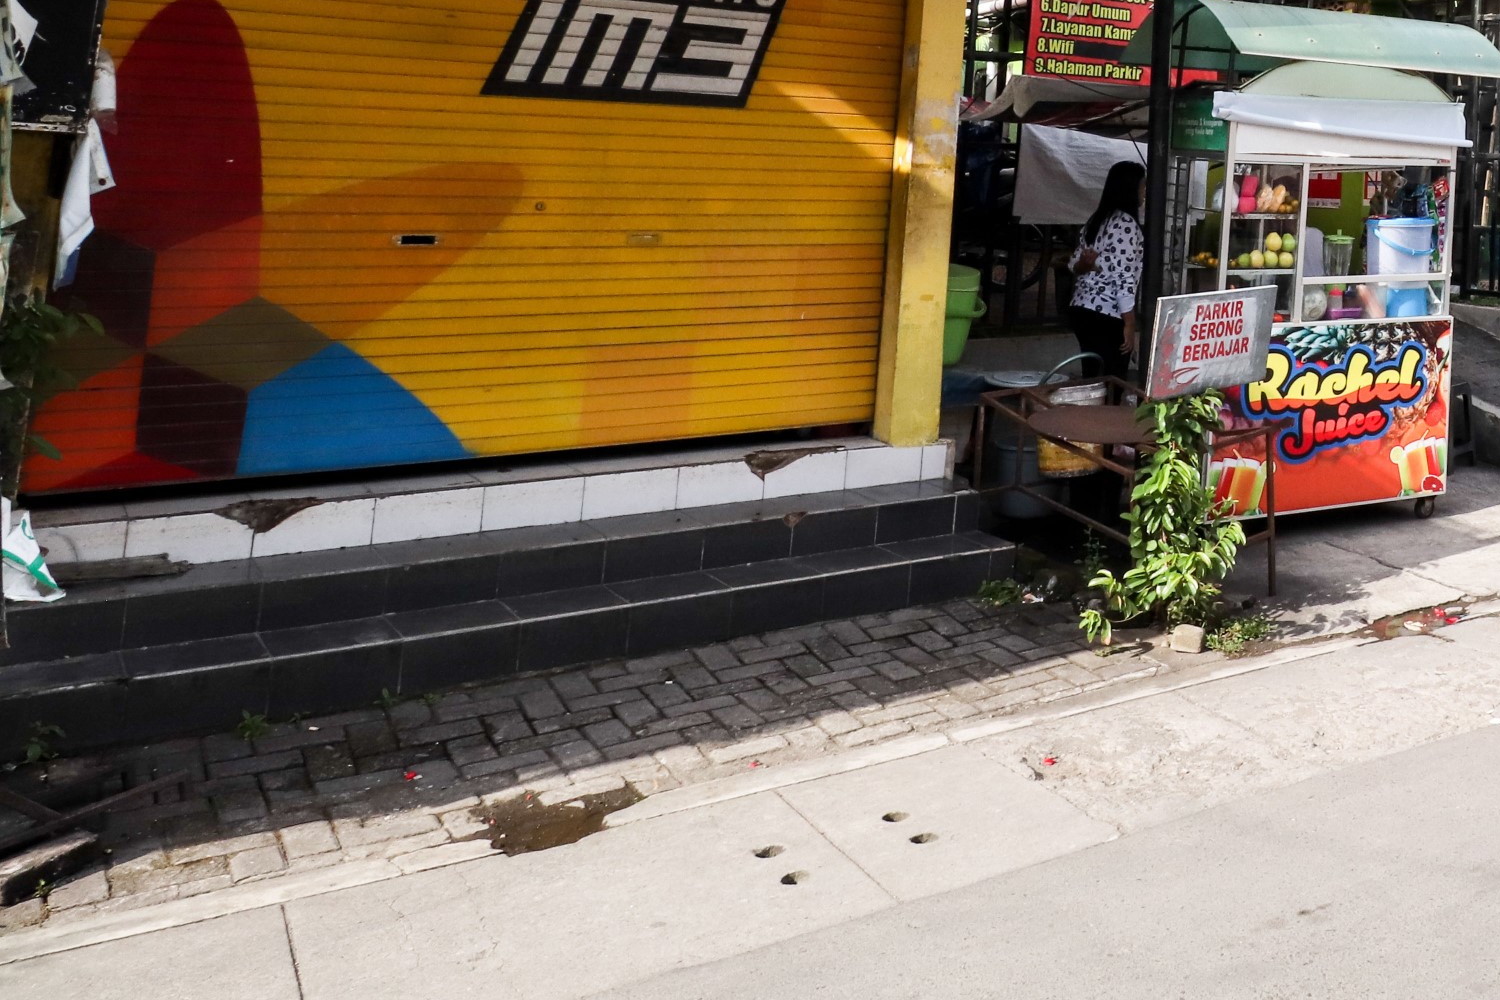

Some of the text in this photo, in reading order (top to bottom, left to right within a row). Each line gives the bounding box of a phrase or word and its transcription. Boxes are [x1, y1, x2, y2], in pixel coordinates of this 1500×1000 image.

[1091, 3, 1131, 21] Umum
[1104, 62, 1143, 81] Parkir
[1195, 299, 1244, 322] PARKIR
[1189, 317, 1244, 342] SERONG
[1181, 336, 1250, 363] BERJAJAR
[1246, 346, 1424, 413] Rachel
[1282, 401, 1387, 457] Juice
